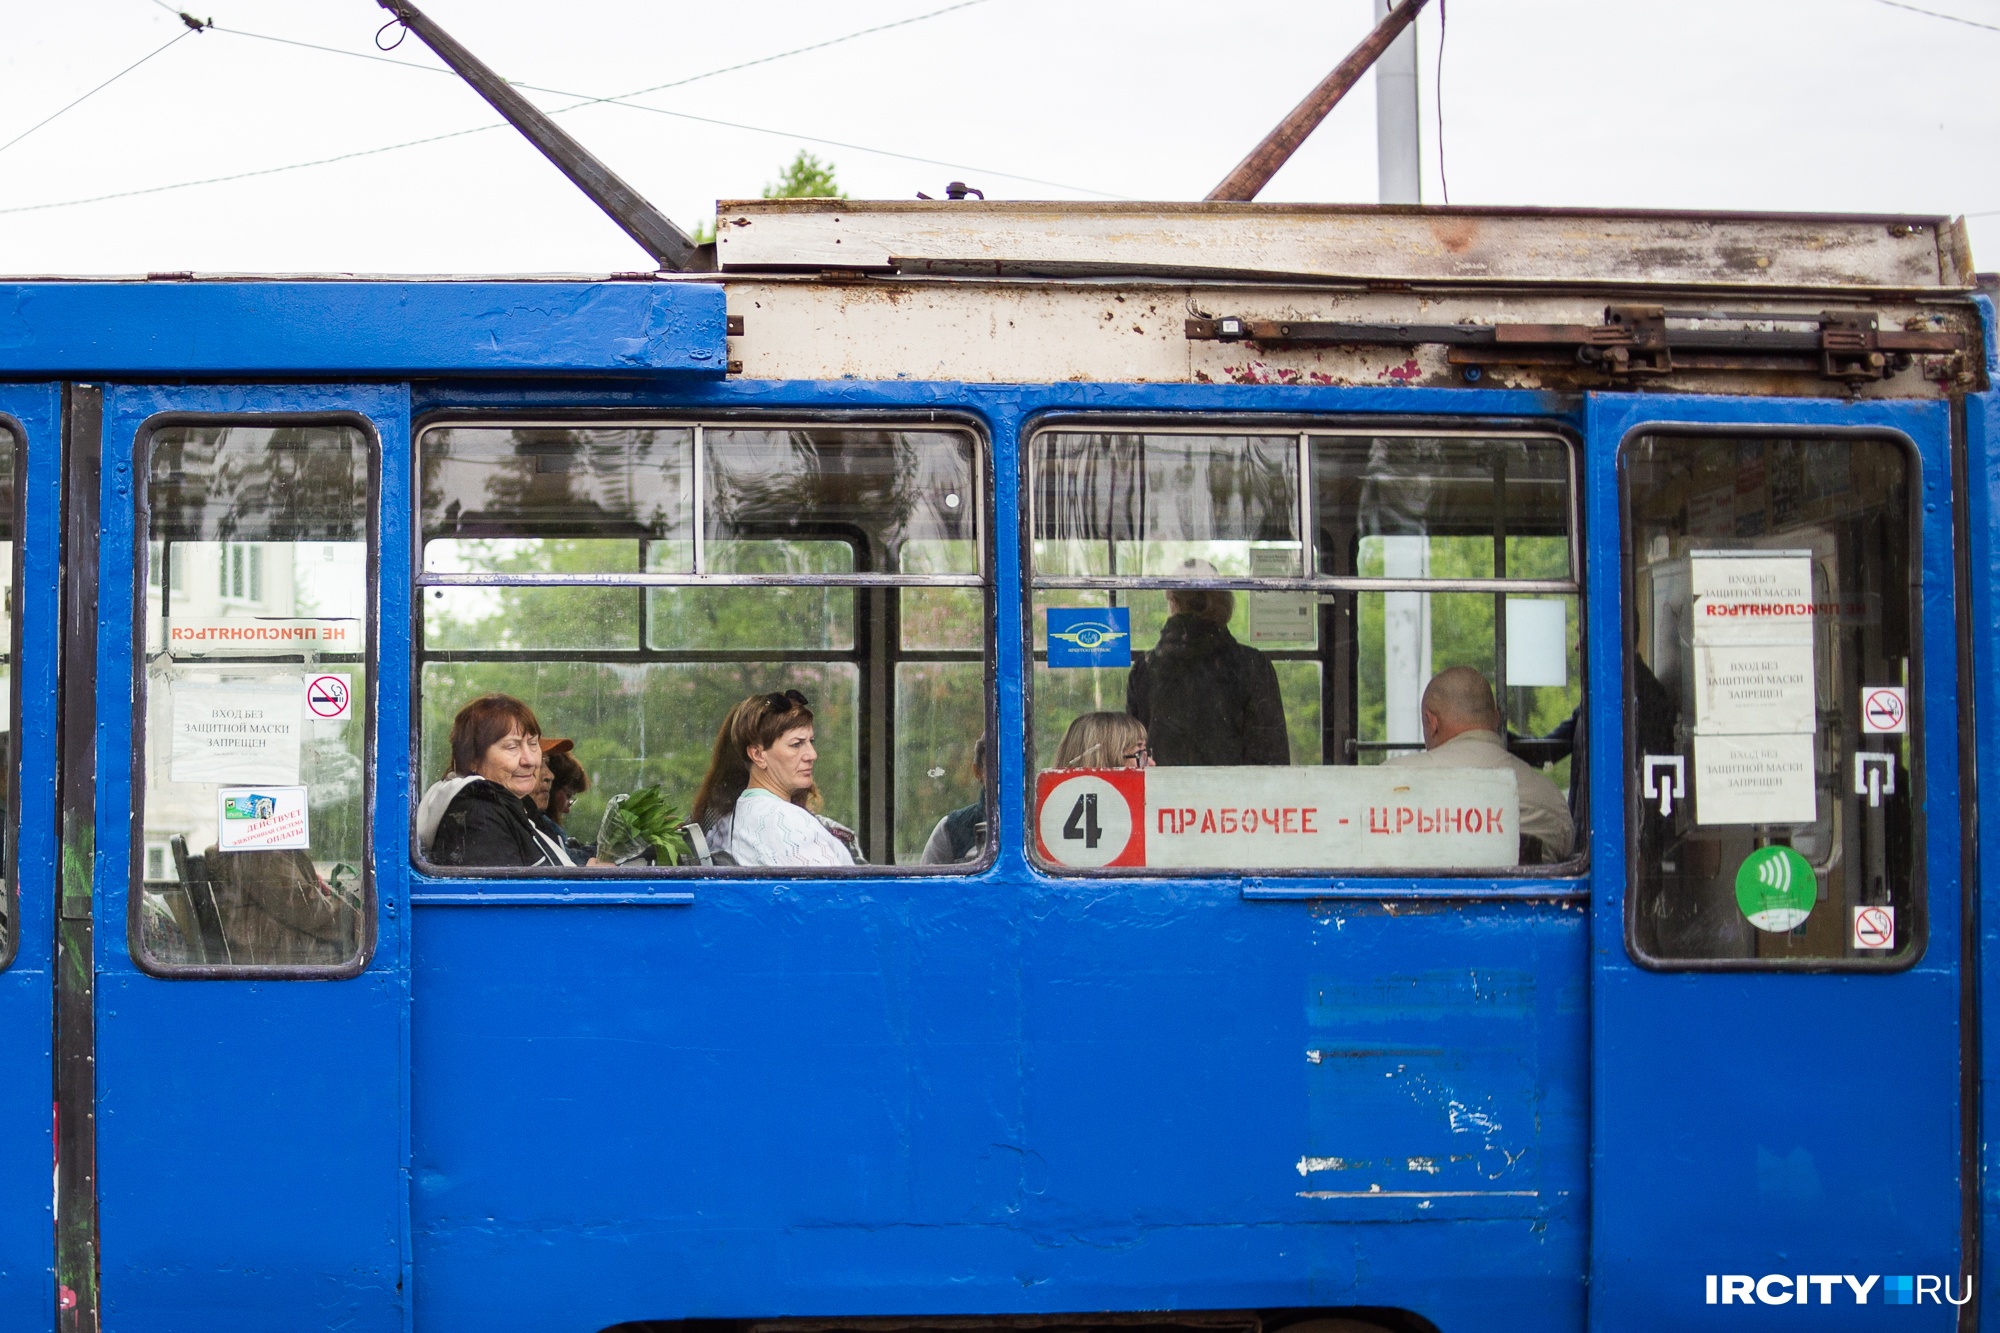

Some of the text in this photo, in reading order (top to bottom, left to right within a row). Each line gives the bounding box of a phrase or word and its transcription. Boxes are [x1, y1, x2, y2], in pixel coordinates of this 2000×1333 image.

[1728, 574, 1776, 586] ВХОД БЕЗ
[1704, 587, 1801, 599] ЗАЩИТНОЙ МАСКИ
[1730, 661, 1778, 672] ВХОД БЕЗ
[1706, 673, 1803, 687] ЗАЩИТНОЙ МАСКИ
[1728, 688, 1783, 700] ЗАПРЕЩЕН
[212, 709, 264, 719] ВХОД БЕЗ
[184, 722, 289, 734] ЗАЩИТНОЙ МАСКИ
[207, 738, 266, 748] ЗАПРЕЩЕН
[1730, 749, 1778, 760] ВХОД БЕЗ
[1706, 761, 1803, 775] ЗАЩИТНОЙ МАСКИ
[1728, 776, 1783, 788] ЗАПРЕЩЕН
[247, 809, 302, 833] ДЕЙСТВУЕТ
[276, 819, 304, 832] СИСТЕМА
[1063, 793, 1102, 848] 4
[266, 828, 304, 844] ОПЛАТЫ
